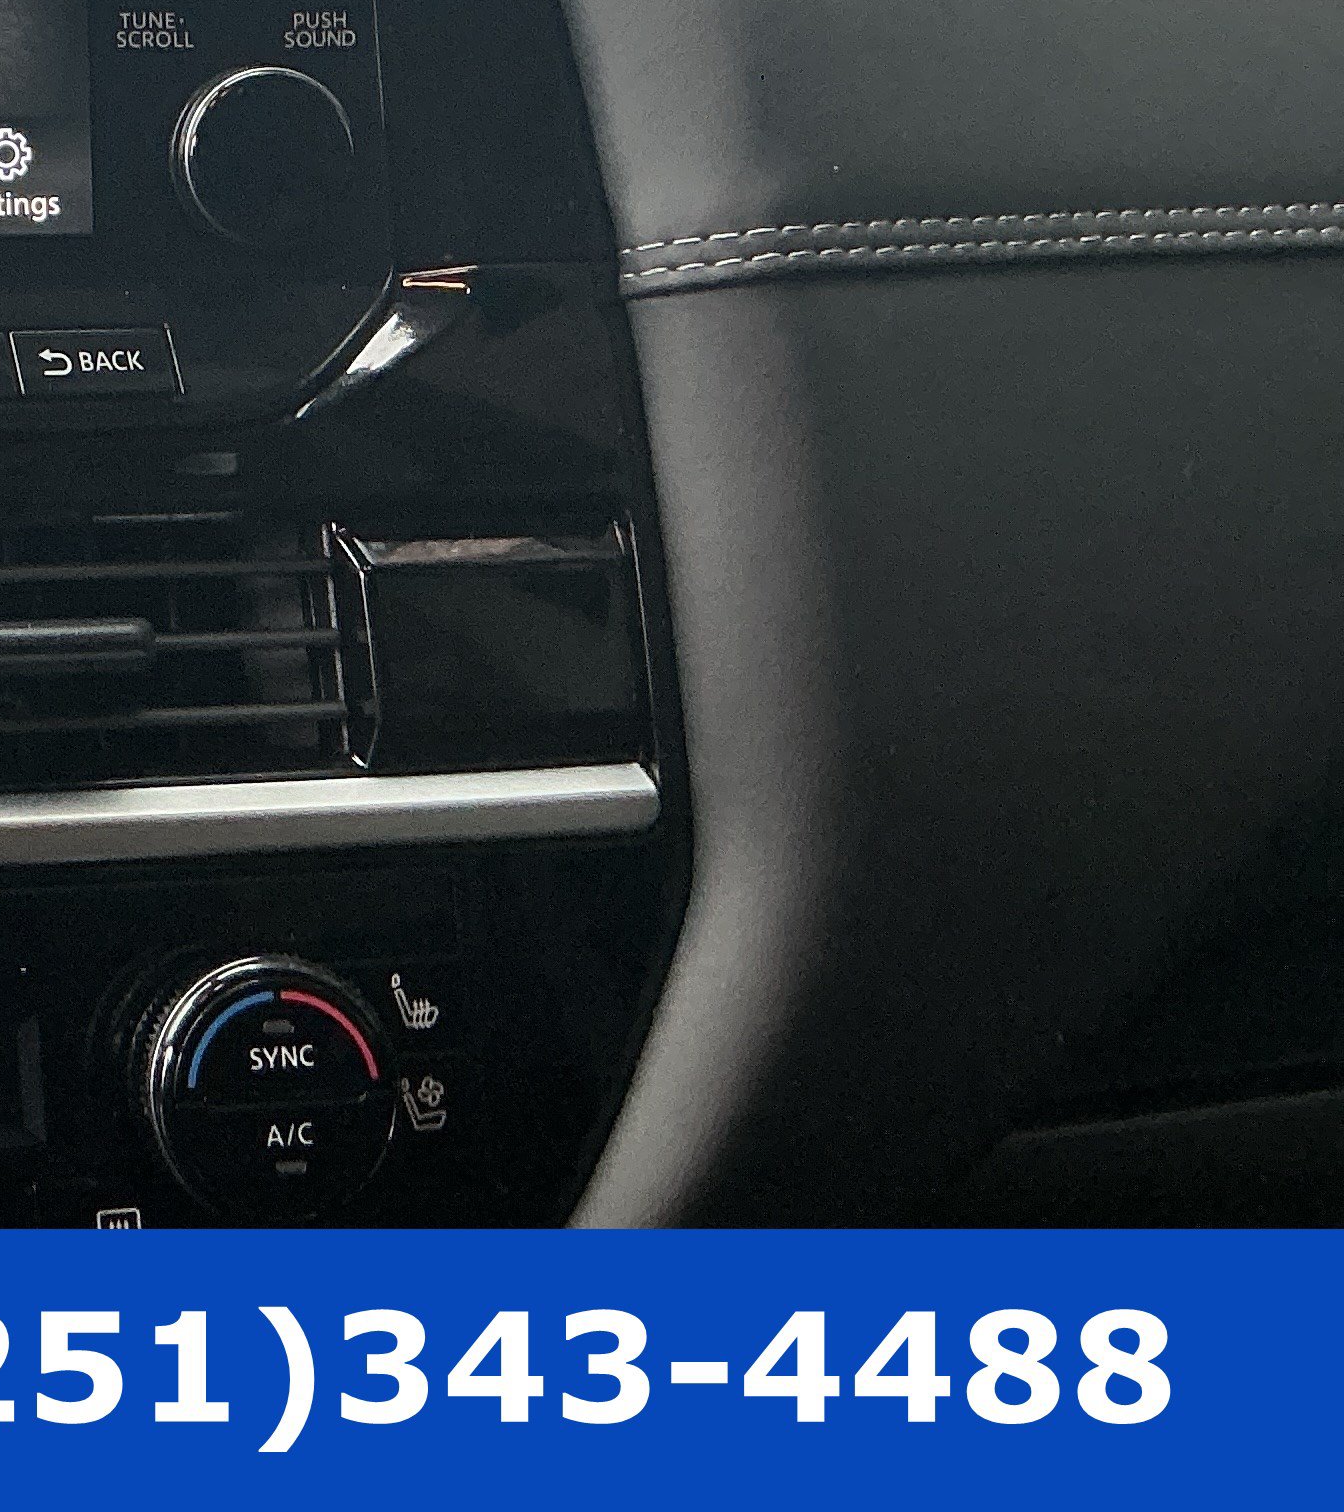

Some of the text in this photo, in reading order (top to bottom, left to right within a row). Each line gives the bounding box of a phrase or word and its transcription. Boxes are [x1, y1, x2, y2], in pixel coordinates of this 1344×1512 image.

[293, 10, 347, 31] PUSH
[116, 30, 195, 50] SCROLL
[283, 29, 356, 50] SOUND
[78, 350, 145, 372] BACK
[249, 1044, 315, 1071] SYNC
[267, 1122, 314, 1147] A/C
